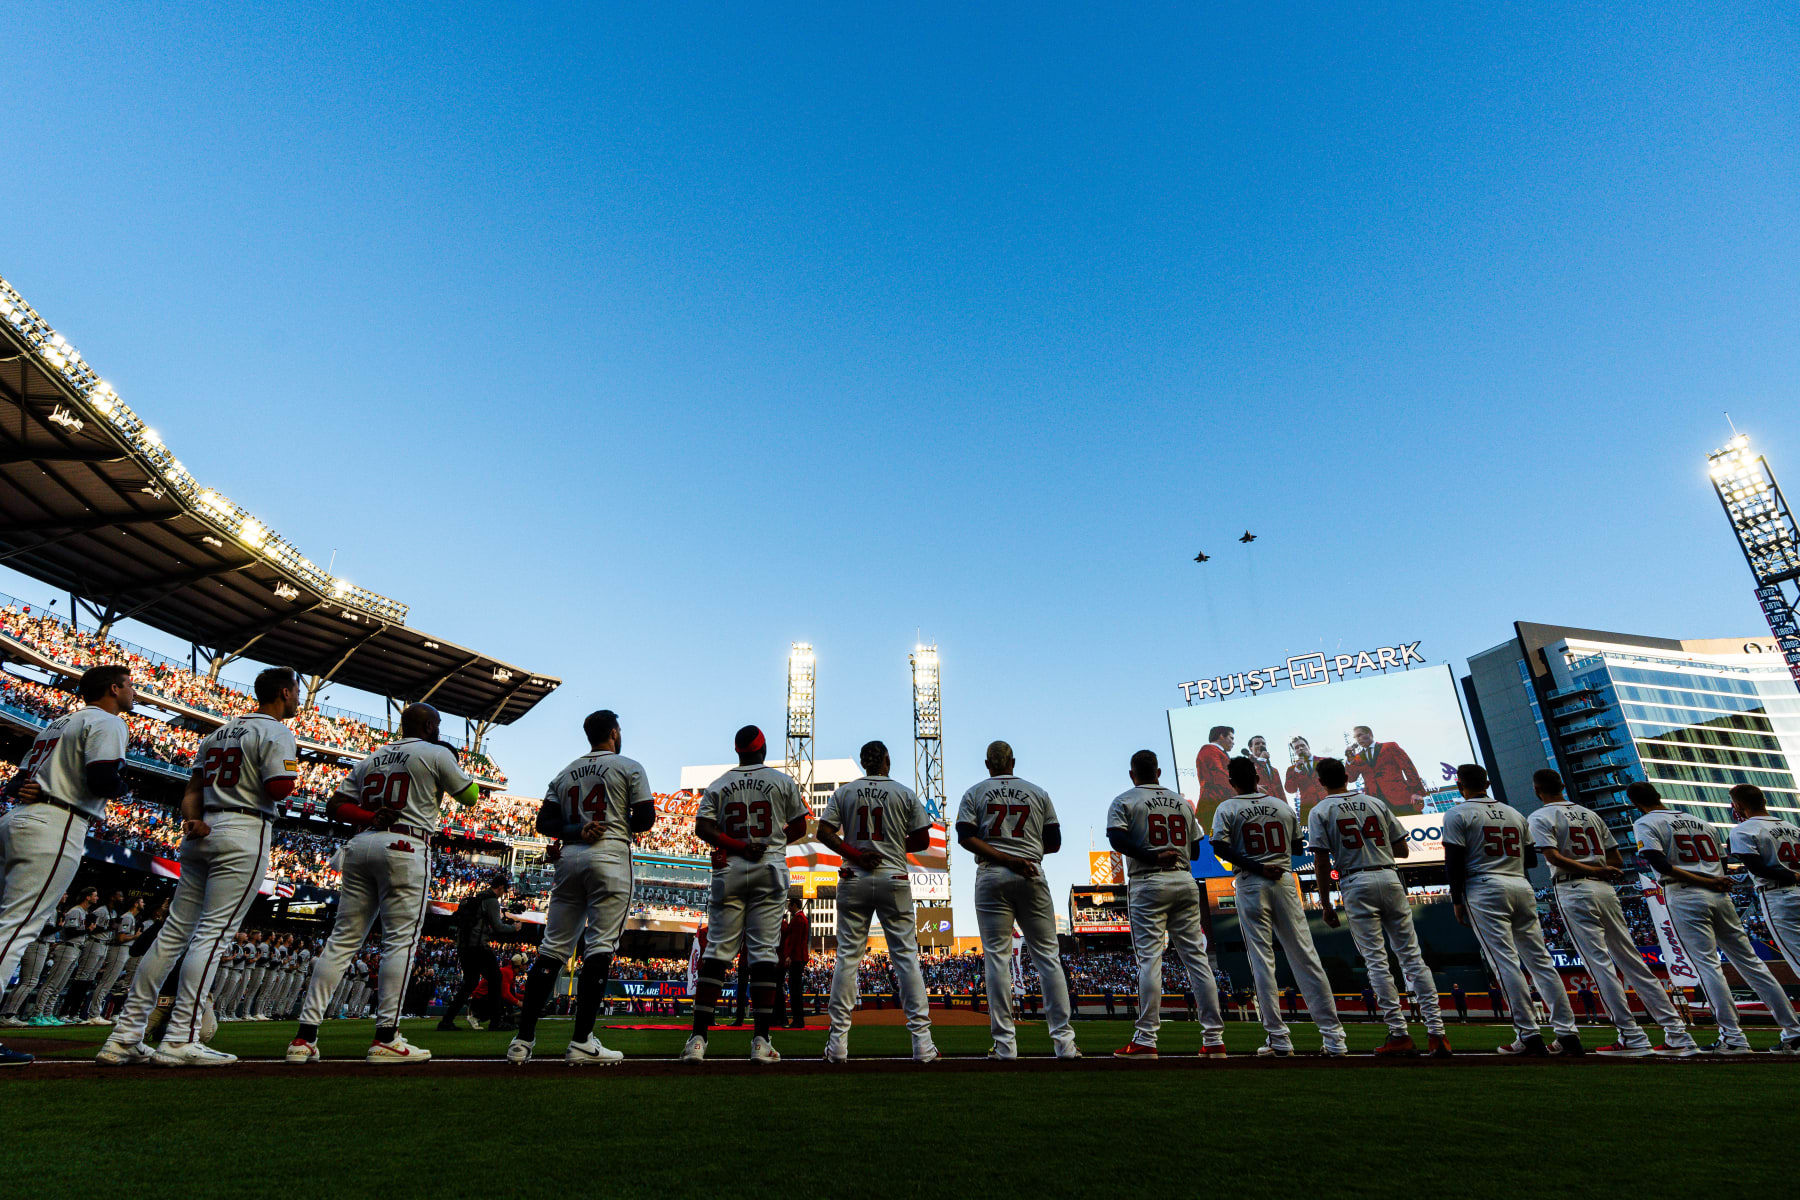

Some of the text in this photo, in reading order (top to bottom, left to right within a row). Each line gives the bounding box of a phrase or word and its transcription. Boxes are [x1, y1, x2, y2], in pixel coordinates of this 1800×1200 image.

[1758, 588, 1776, 599] 1872
[1764, 600, 1782, 611] 1874
[1770, 613, 1787, 624] 1877
[1775, 626, 1794, 637] 1883
[1782, 640, 1800, 651] 1892
[1178, 640, 1426, 702] TRUIST PARK
[27, 737, 60, 780] 27
[203, 747, 243, 788] 28
[373, 751, 411, 768] OZUNA
[570, 764, 610, 782] DUVALL
[362, 771, 412, 811] 20
[721, 779, 765, 798] HARRIS
[857, 787, 889, 802] ARCIA
[984, 785, 1030, 804] JIMÉNEZ
[302, 802, 316, 815] 10
[567, 783, 608, 825] 14
[1144, 796, 1183, 812] MATZEK
[1239, 805, 1279, 821] CHAVEZ
[1337, 802, 1367, 814] FRIED
[724, 800, 773, 839] 23
[856, 805, 885, 842] 11
[986, 803, 1031, 838] 77
[1485, 810, 1506, 821] LEE
[1564, 811, 1589, 822] SALE
[464, 829, 477, 841] 44
[1147, 813, 1188, 847] 68
[1335, 815, 1387, 850] 54
[1669, 820, 1705, 832] MORTON
[1241, 820, 1288, 855] 60
[1482, 825, 1522, 858] 52
[1569, 826, 1605, 856] 51
[1673, 834, 1720, 863] 50
[1091, 850, 1122, 884] HOME
[1660, 926, 1698, 979] Braves
[623, 982, 687, 996] WE ARE Brav
